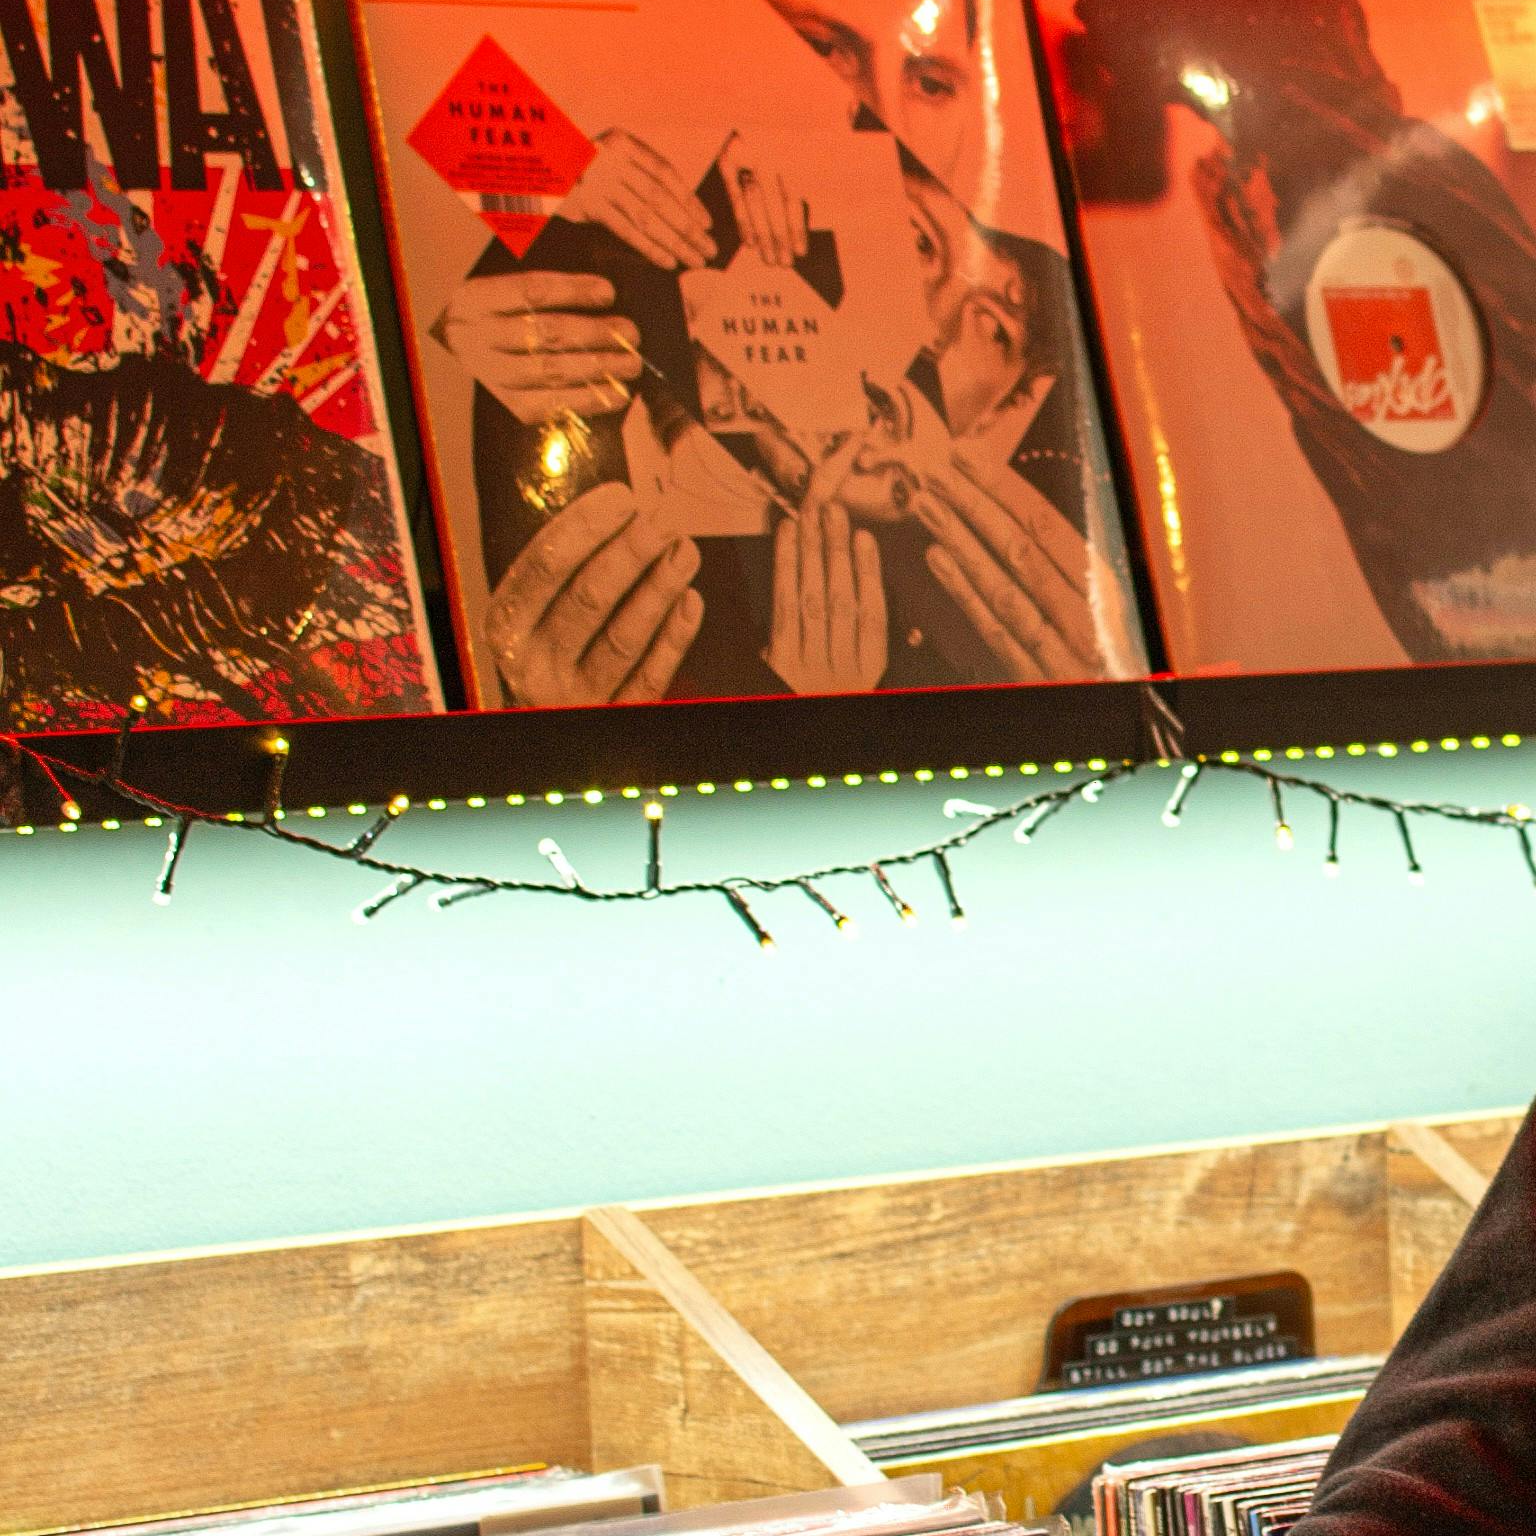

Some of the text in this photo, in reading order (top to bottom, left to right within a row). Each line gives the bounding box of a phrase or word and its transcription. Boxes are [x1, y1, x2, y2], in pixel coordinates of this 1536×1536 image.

[478, 81, 510, 94] THE
[448, 101, 546, 122] HUMAN
[469, 126, 532, 146] FEAR
[750, 291, 782, 307] THE
[722, 317, 819, 336] HUMAN
[745, 344, 806, 363] FEAR
